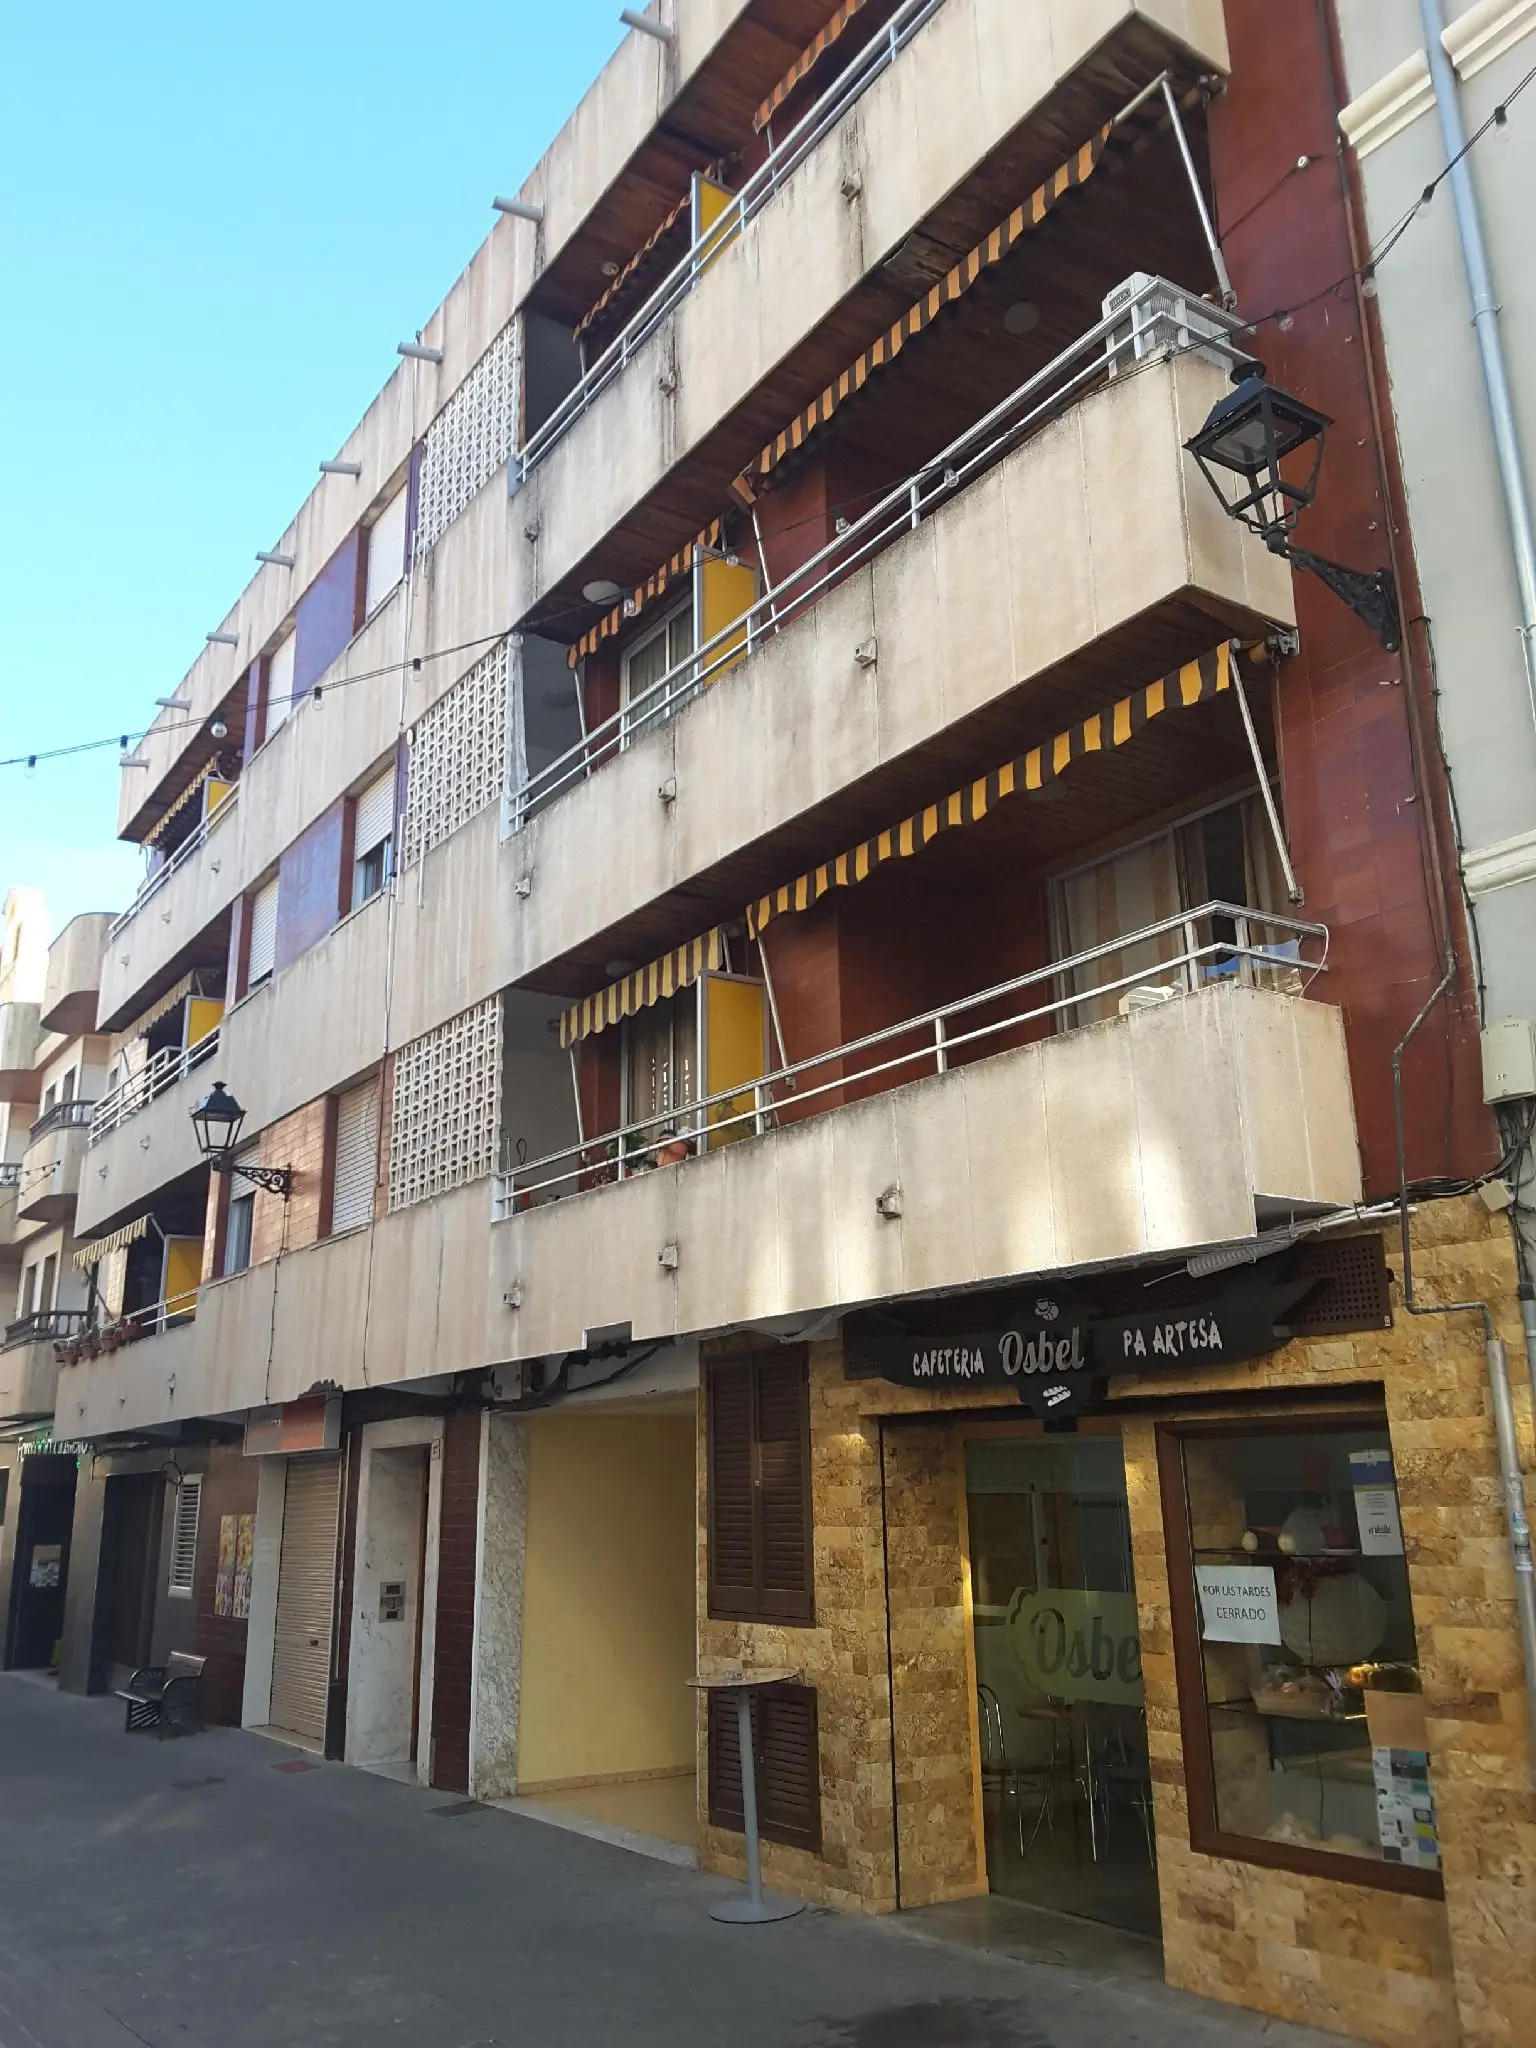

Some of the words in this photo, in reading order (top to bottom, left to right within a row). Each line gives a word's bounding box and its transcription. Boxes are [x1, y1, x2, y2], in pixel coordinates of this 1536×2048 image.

[998, 1326, 1085, 1376] Osbel
[1123, 1328, 1147, 1358] PA
[912, 1346, 985, 1379] CAFETERIA
[1203, 1585, 1220, 1596] POR
[1222, 1586, 1236, 1596] LAS
[1237, 1586, 1271, 1597] TARDES
[1216, 1606, 1266, 1620] CERRADO
[1030, 1608, 1143, 1684] Osbe
